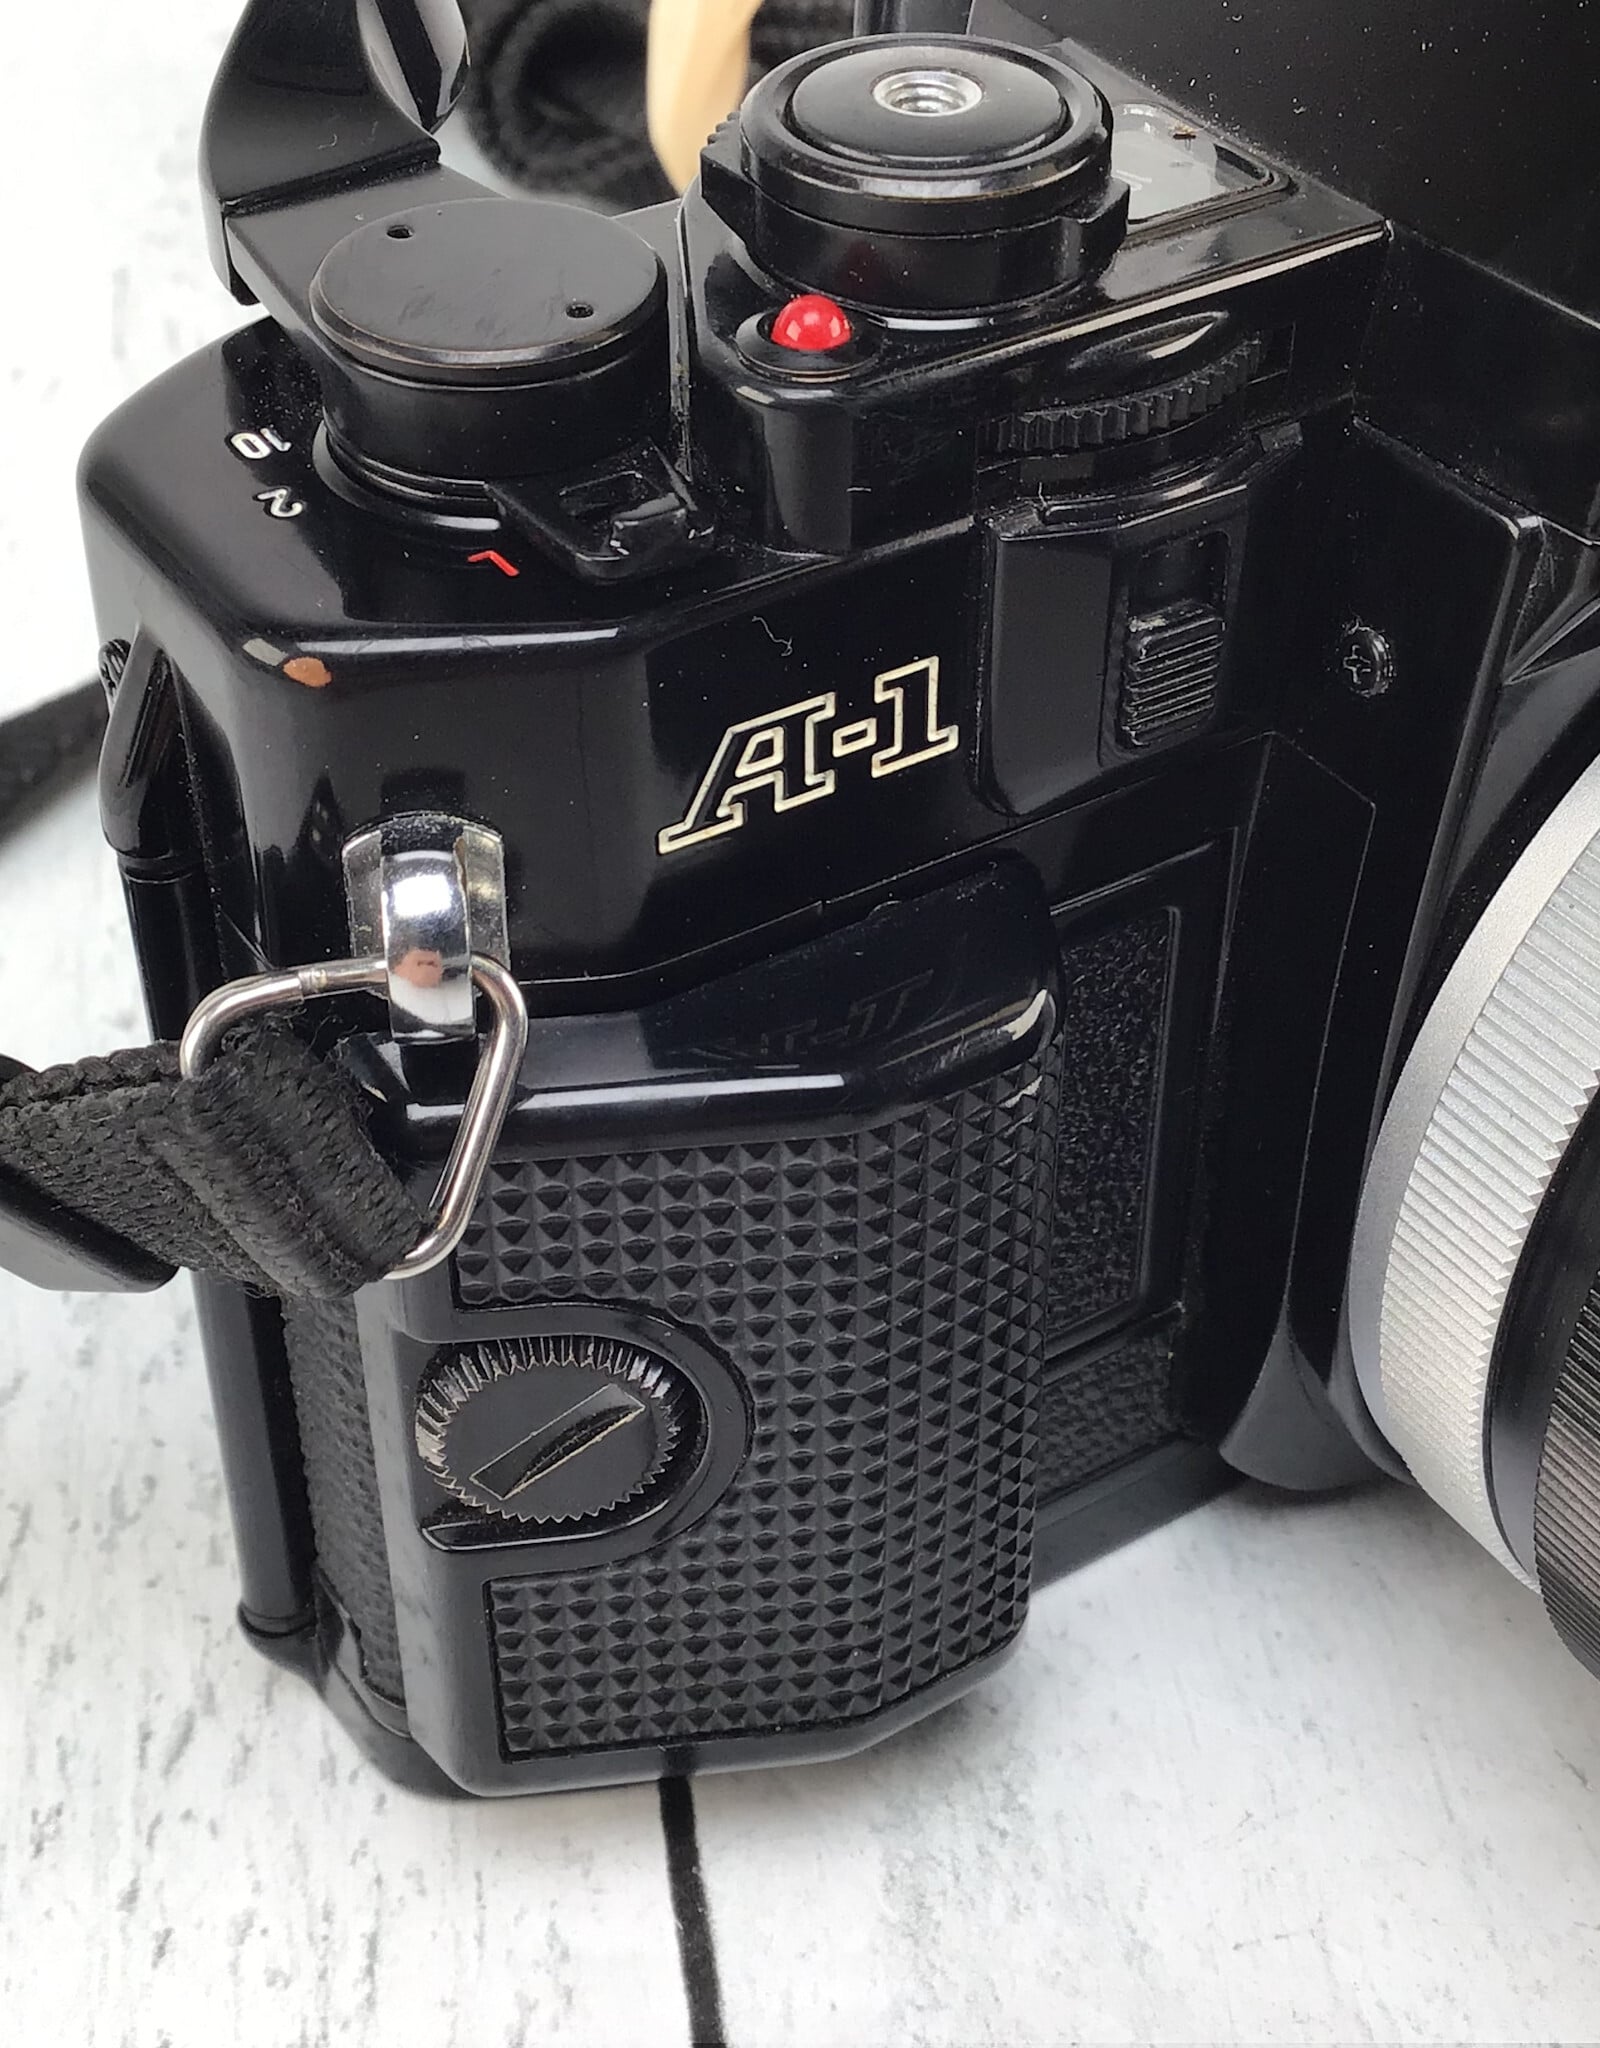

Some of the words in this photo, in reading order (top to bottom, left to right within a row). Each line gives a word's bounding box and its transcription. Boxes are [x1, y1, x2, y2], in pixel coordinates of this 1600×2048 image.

[230, 427, 292, 460] 10
[257, 487, 302, 518] 2
[657, 655, 959, 855] A-1
